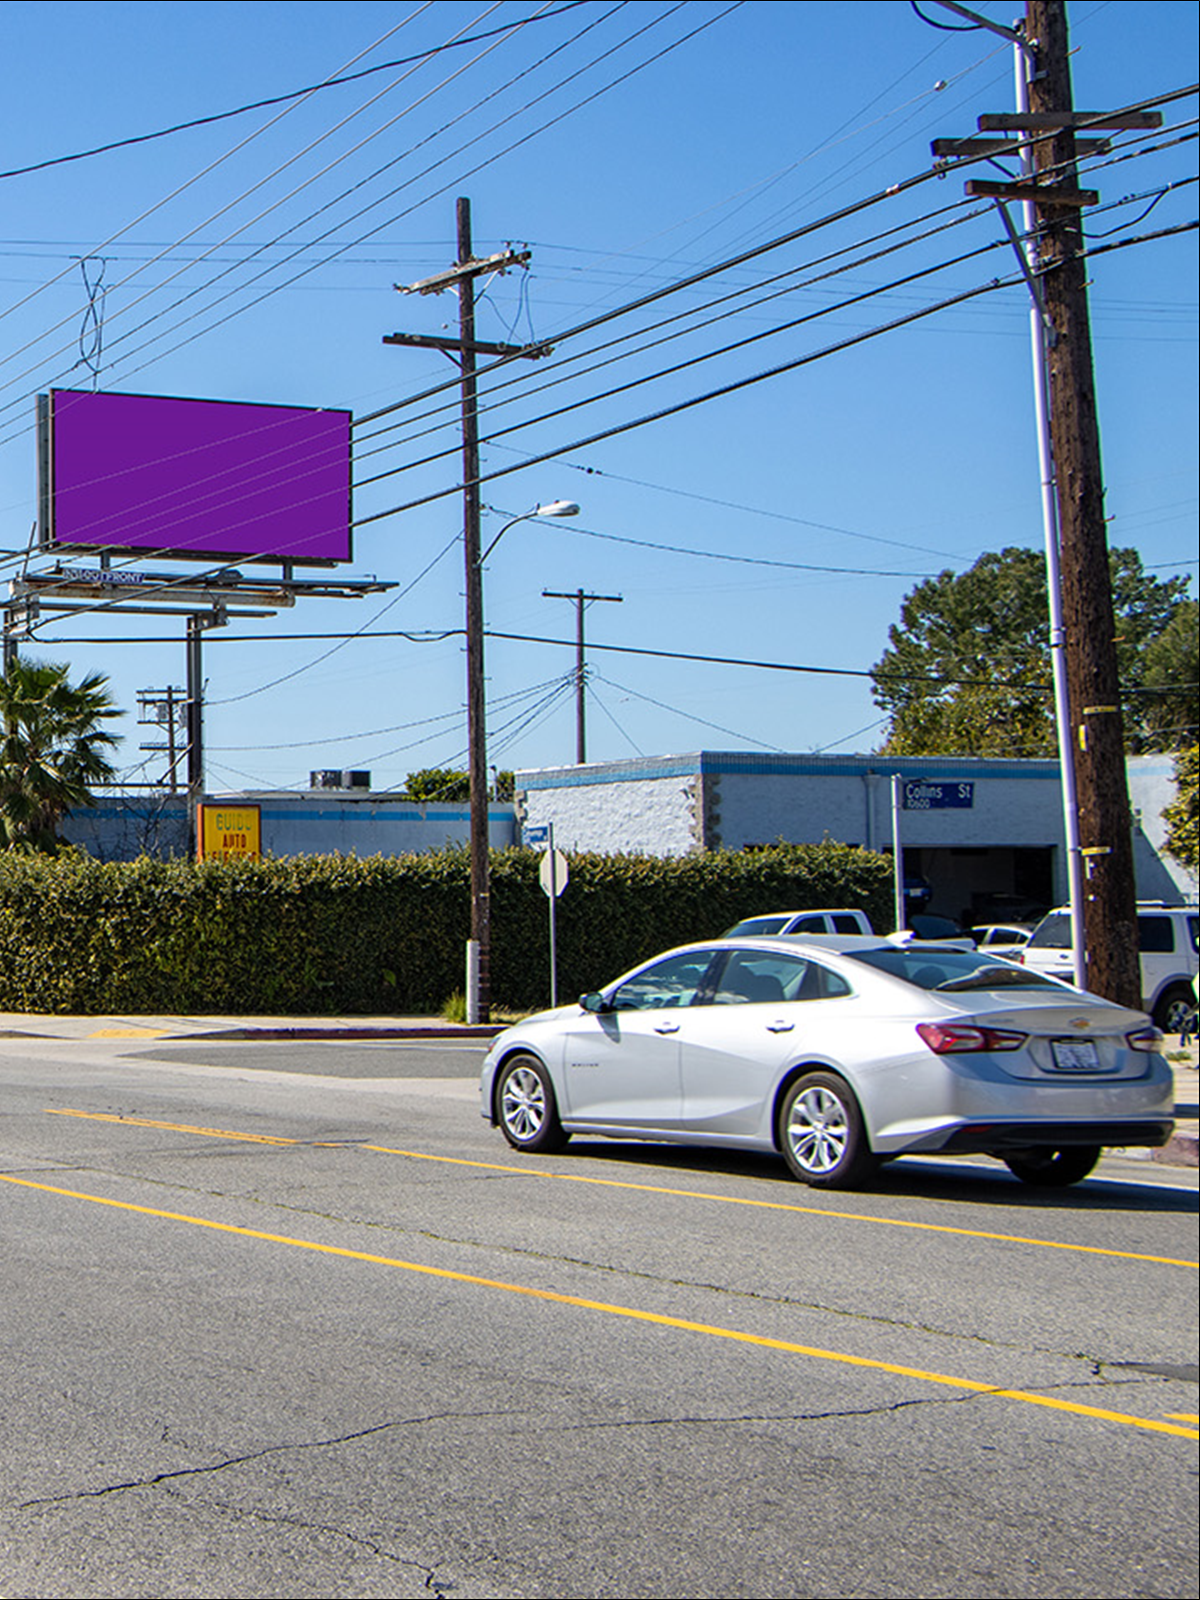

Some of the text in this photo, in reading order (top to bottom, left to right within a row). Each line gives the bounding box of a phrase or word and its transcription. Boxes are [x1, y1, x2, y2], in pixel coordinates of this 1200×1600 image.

[906, 783, 971, 798] Collins St
[223, 834, 246, 848] AUTO
